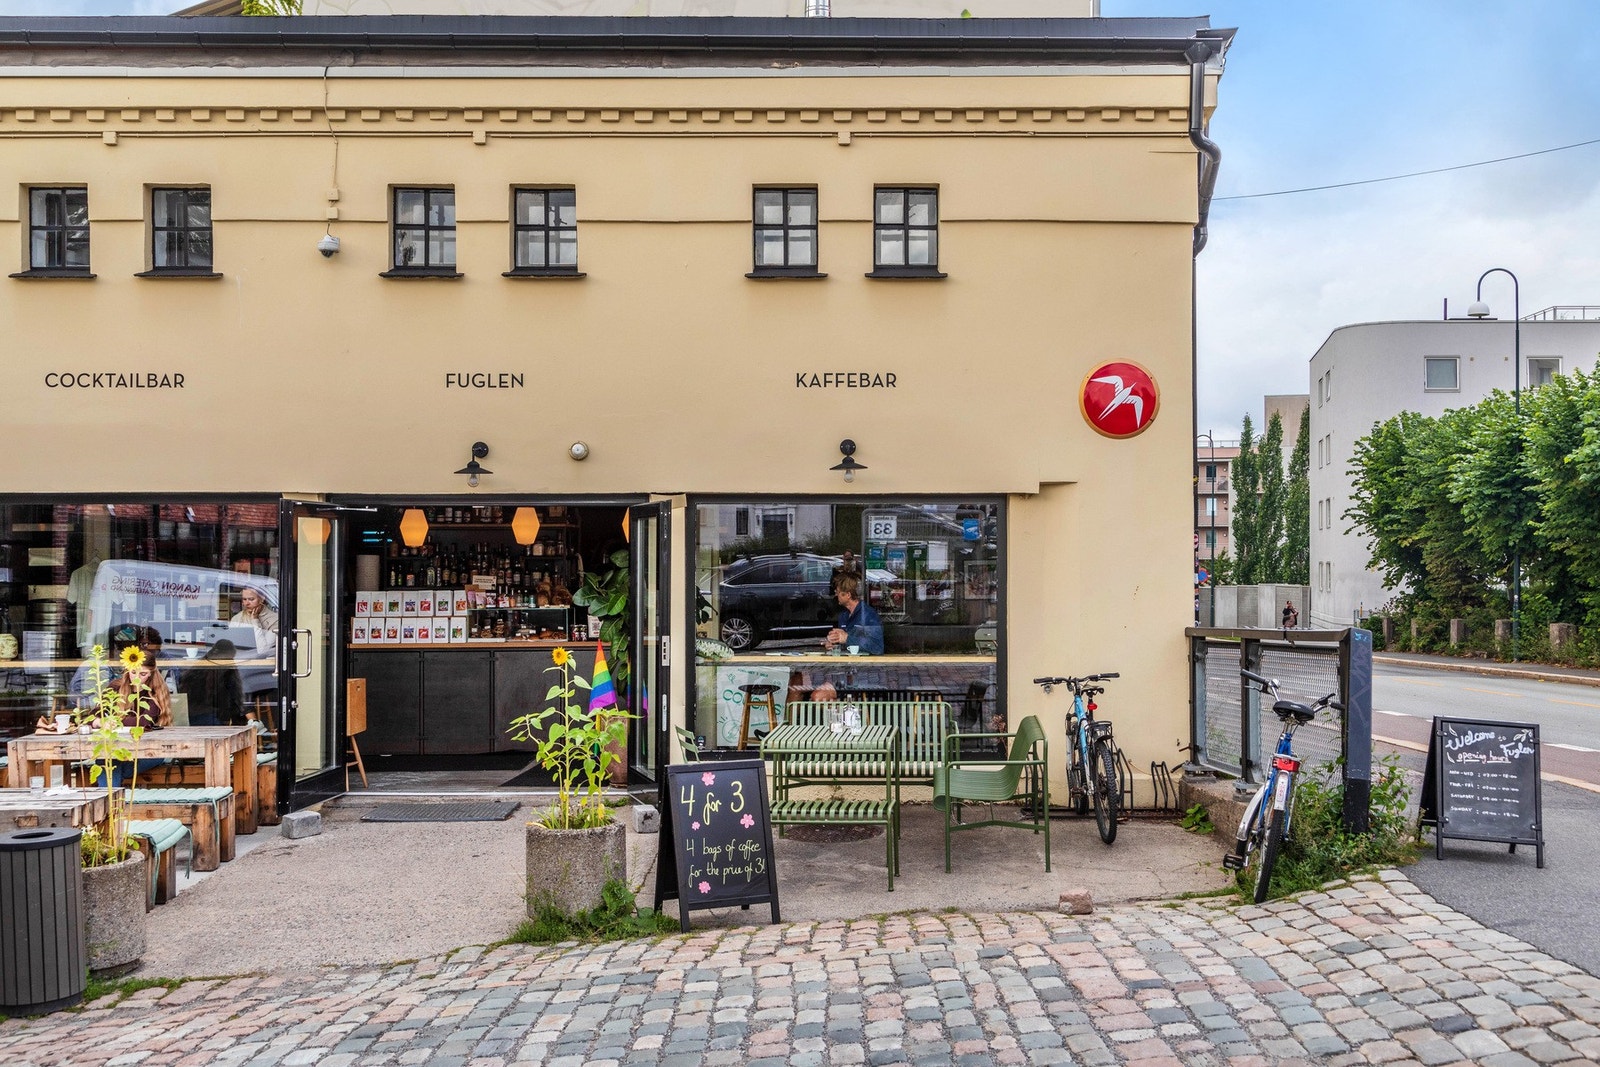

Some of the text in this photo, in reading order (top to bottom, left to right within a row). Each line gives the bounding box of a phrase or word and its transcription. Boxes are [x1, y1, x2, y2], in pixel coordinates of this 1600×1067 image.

[45, 372, 185, 388] COCKTAILBAR
[445, 372, 524, 388] FUGLEN
[795, 372, 898, 388] KAFFEBAR
[1445, 730, 1496, 750] Welcome
[1458, 751, 1487, 764] opening
[1500, 742, 1535, 758] Fuglen
[680, 781, 745, 825] 4 for 3
[686, 838, 761, 862] 4 bags of coffee
[688, 858, 766, 888] for the price of 3!
